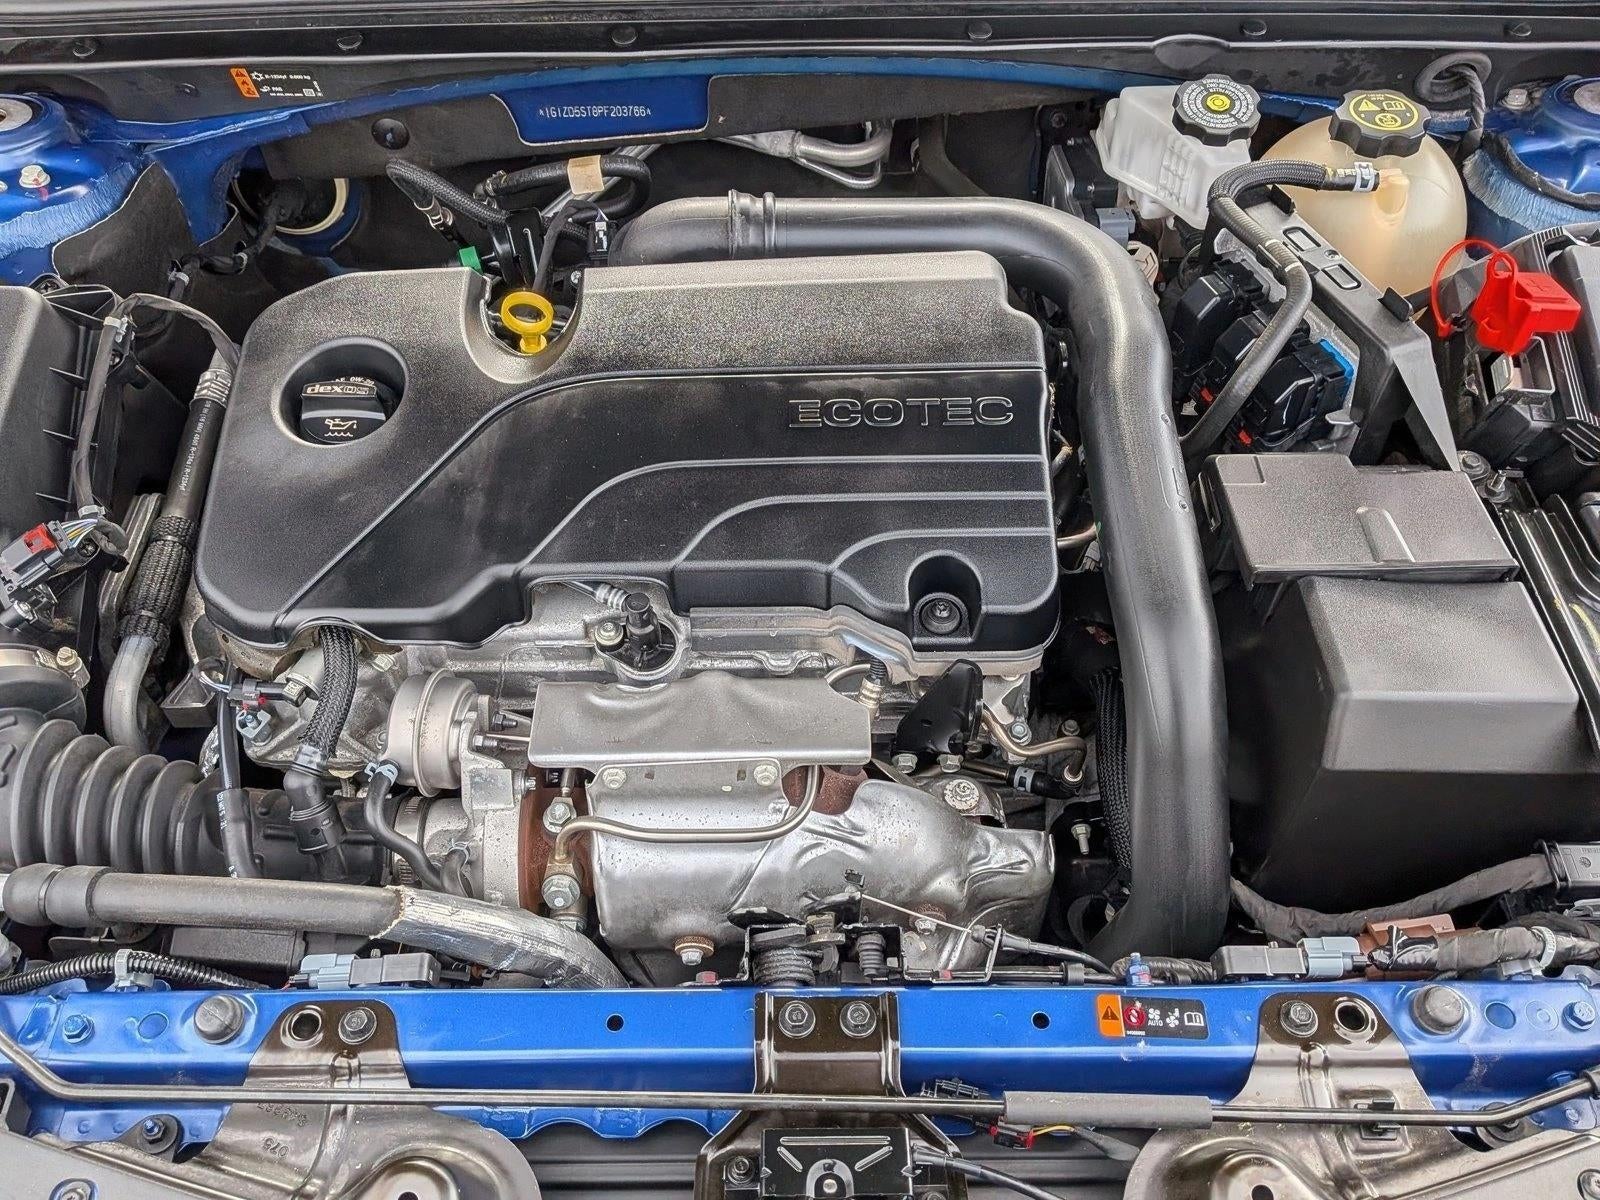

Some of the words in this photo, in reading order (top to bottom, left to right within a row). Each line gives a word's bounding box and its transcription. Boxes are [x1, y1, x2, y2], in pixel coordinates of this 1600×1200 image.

[306, 384, 370, 395] dexos
[788, 396, 1015, 428] ECOTEC
[1147, 1019, 1164, 1027] AUTO
